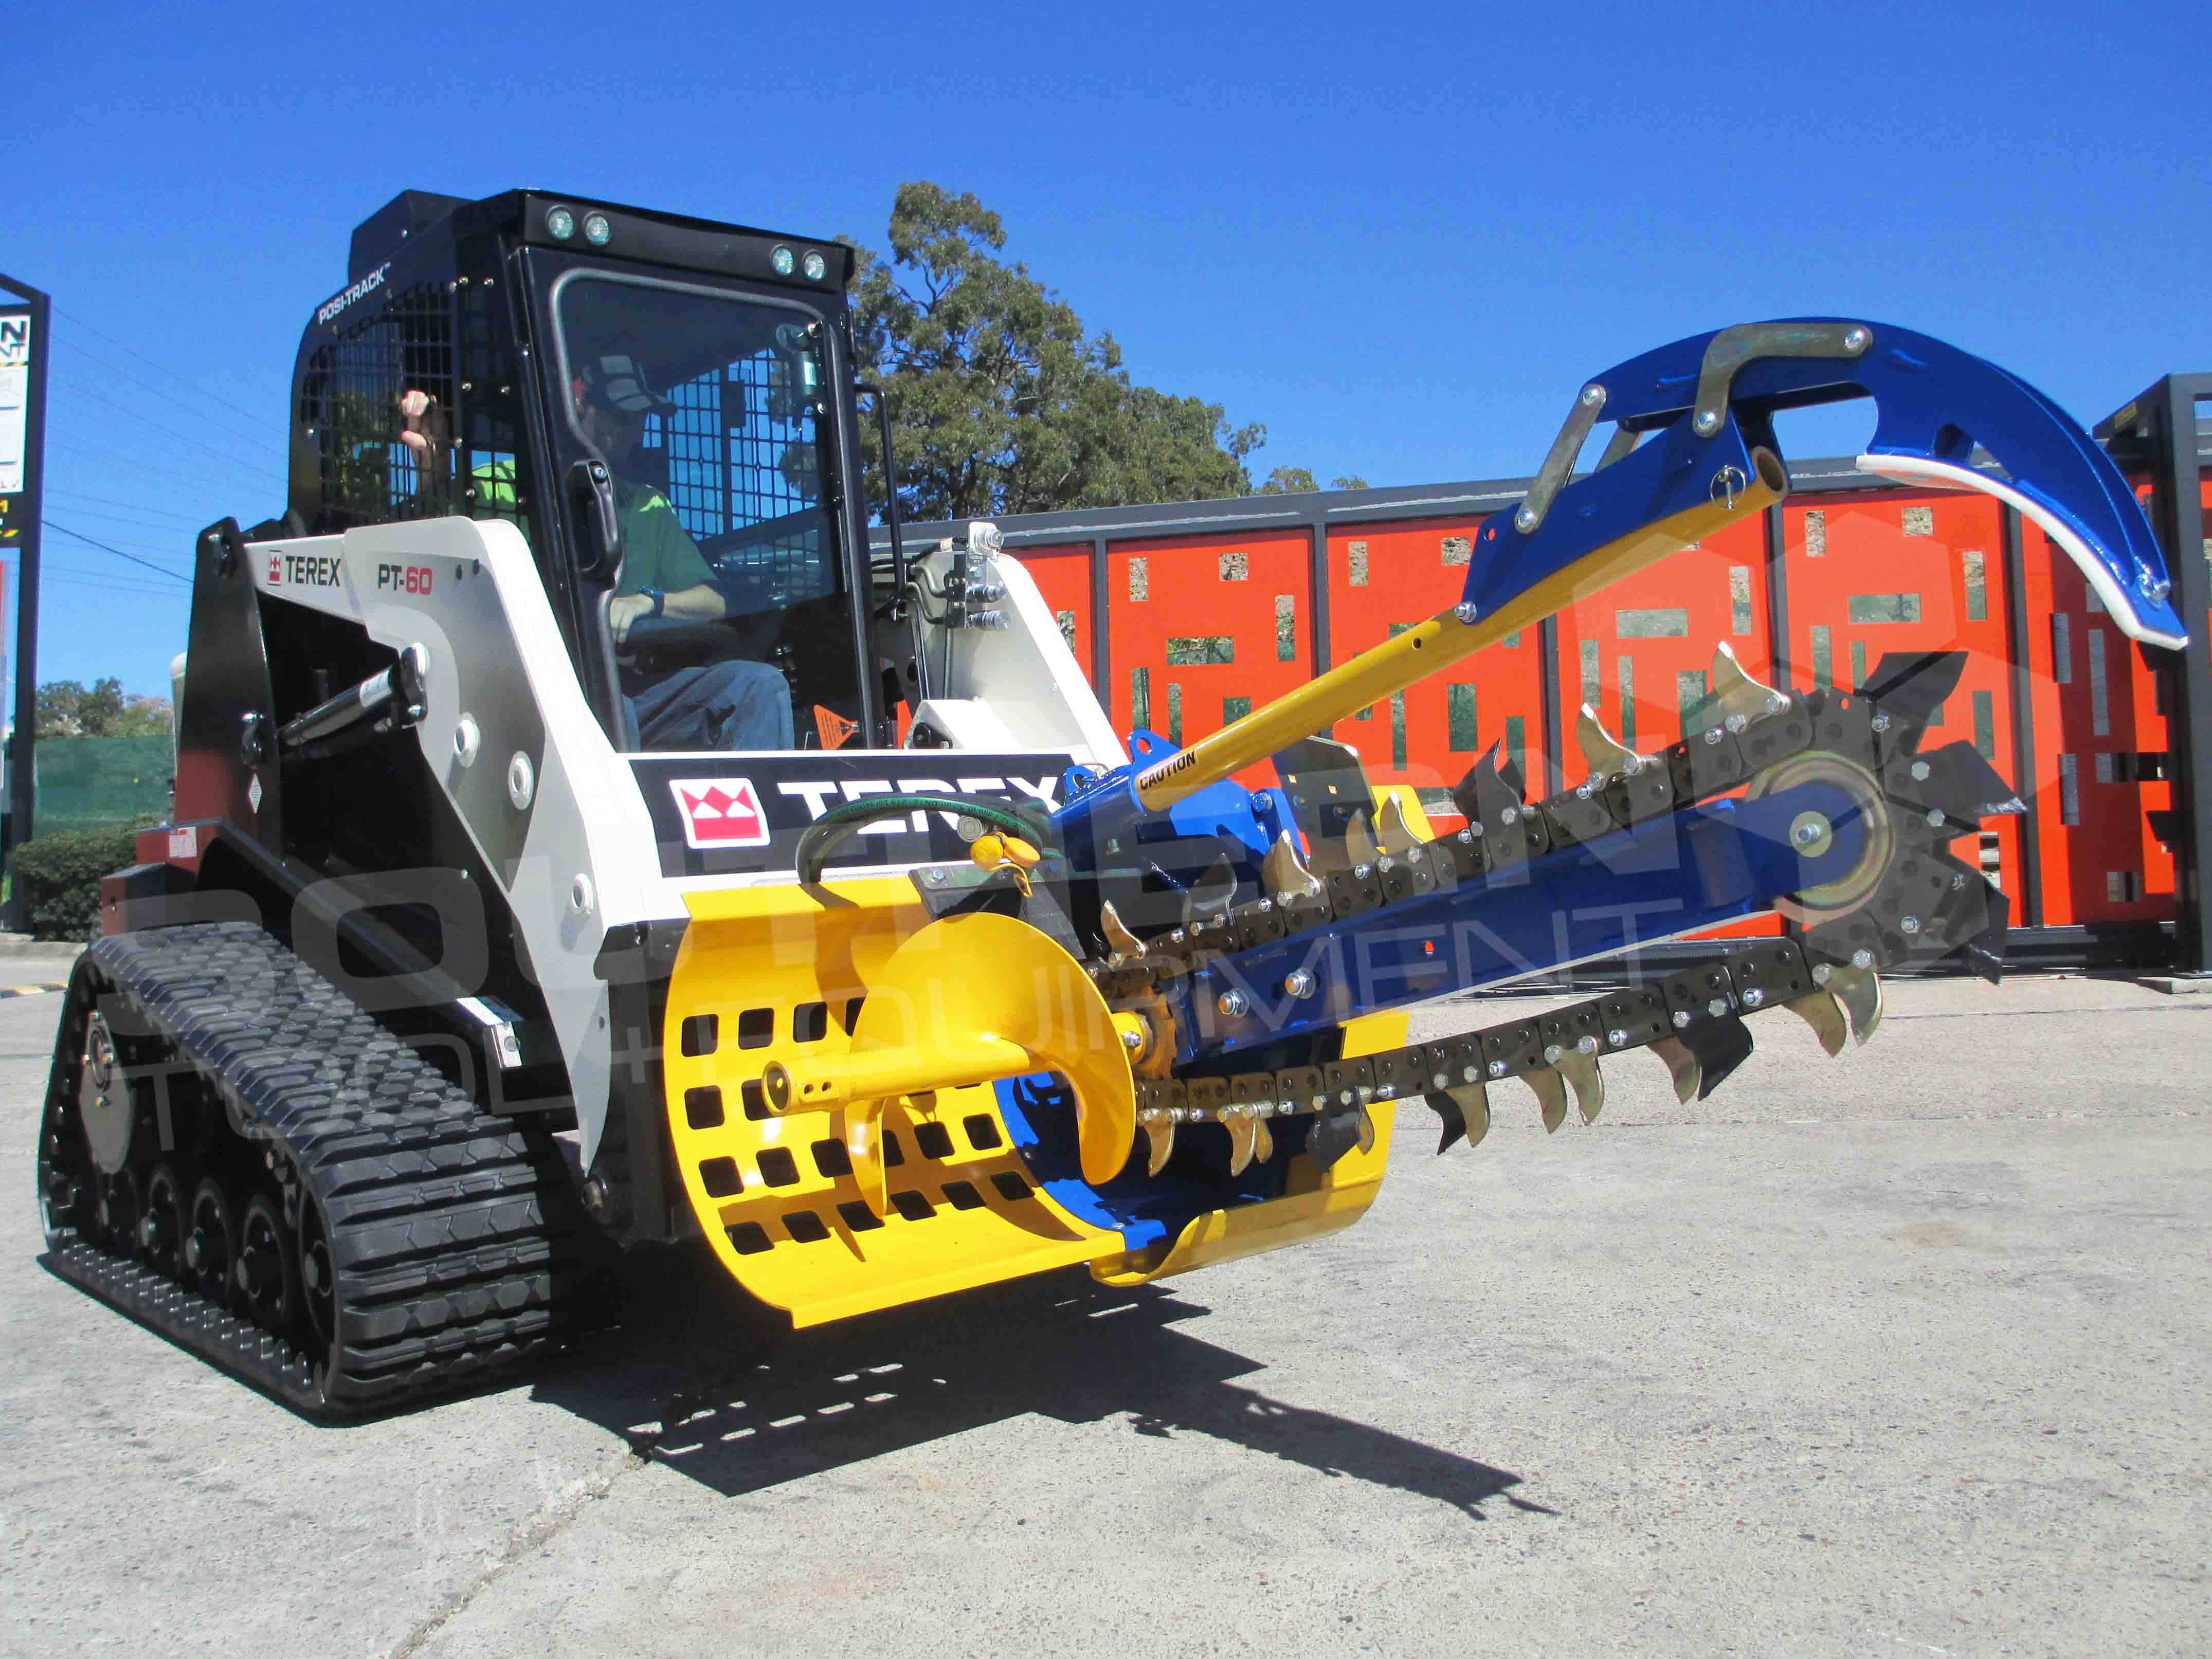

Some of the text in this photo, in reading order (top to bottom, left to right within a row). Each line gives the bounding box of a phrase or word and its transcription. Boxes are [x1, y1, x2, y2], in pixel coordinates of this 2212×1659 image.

[285, 555, 342, 587] TEREX
[378, 563, 433, 596] PT-60
[1139, 750, 1196, 790] CAUTION
